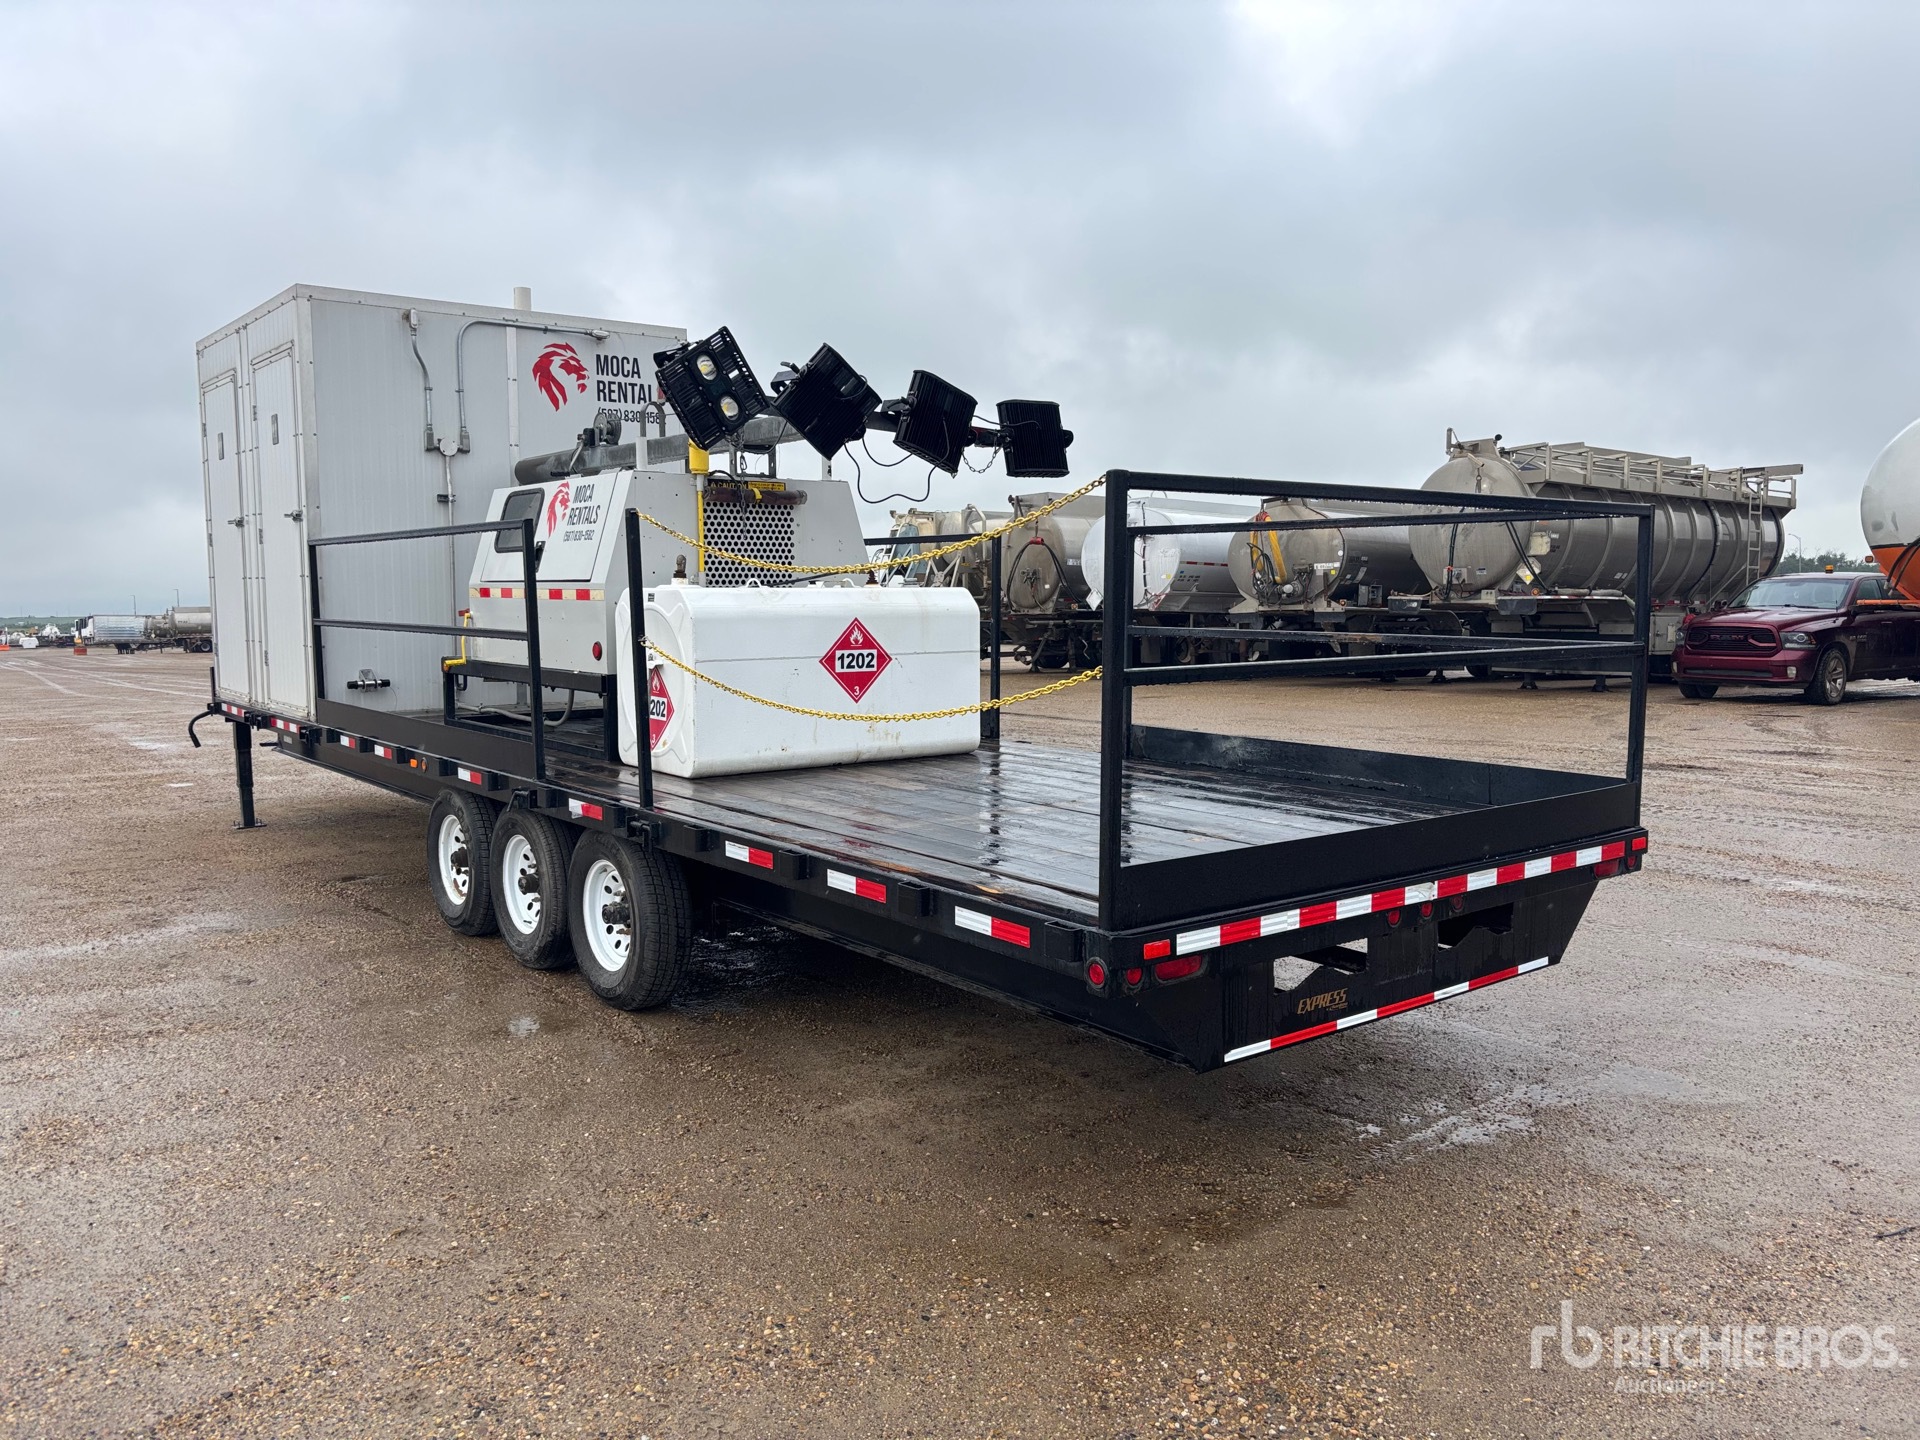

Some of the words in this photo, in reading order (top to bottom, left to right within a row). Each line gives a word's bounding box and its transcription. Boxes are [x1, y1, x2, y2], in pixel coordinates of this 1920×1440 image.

[596, 354, 641, 379] MOCA
[597, 380, 654, 404] RENTAL
[573, 484, 595, 504] MOCA
[567, 505, 601, 526] RENTALS
[837, 652, 875, 669] 1202
[854, 686, 860, 696] 3
[650, 699, 666, 718] 202
[1297, 987, 1348, 1015] EXPRESS
